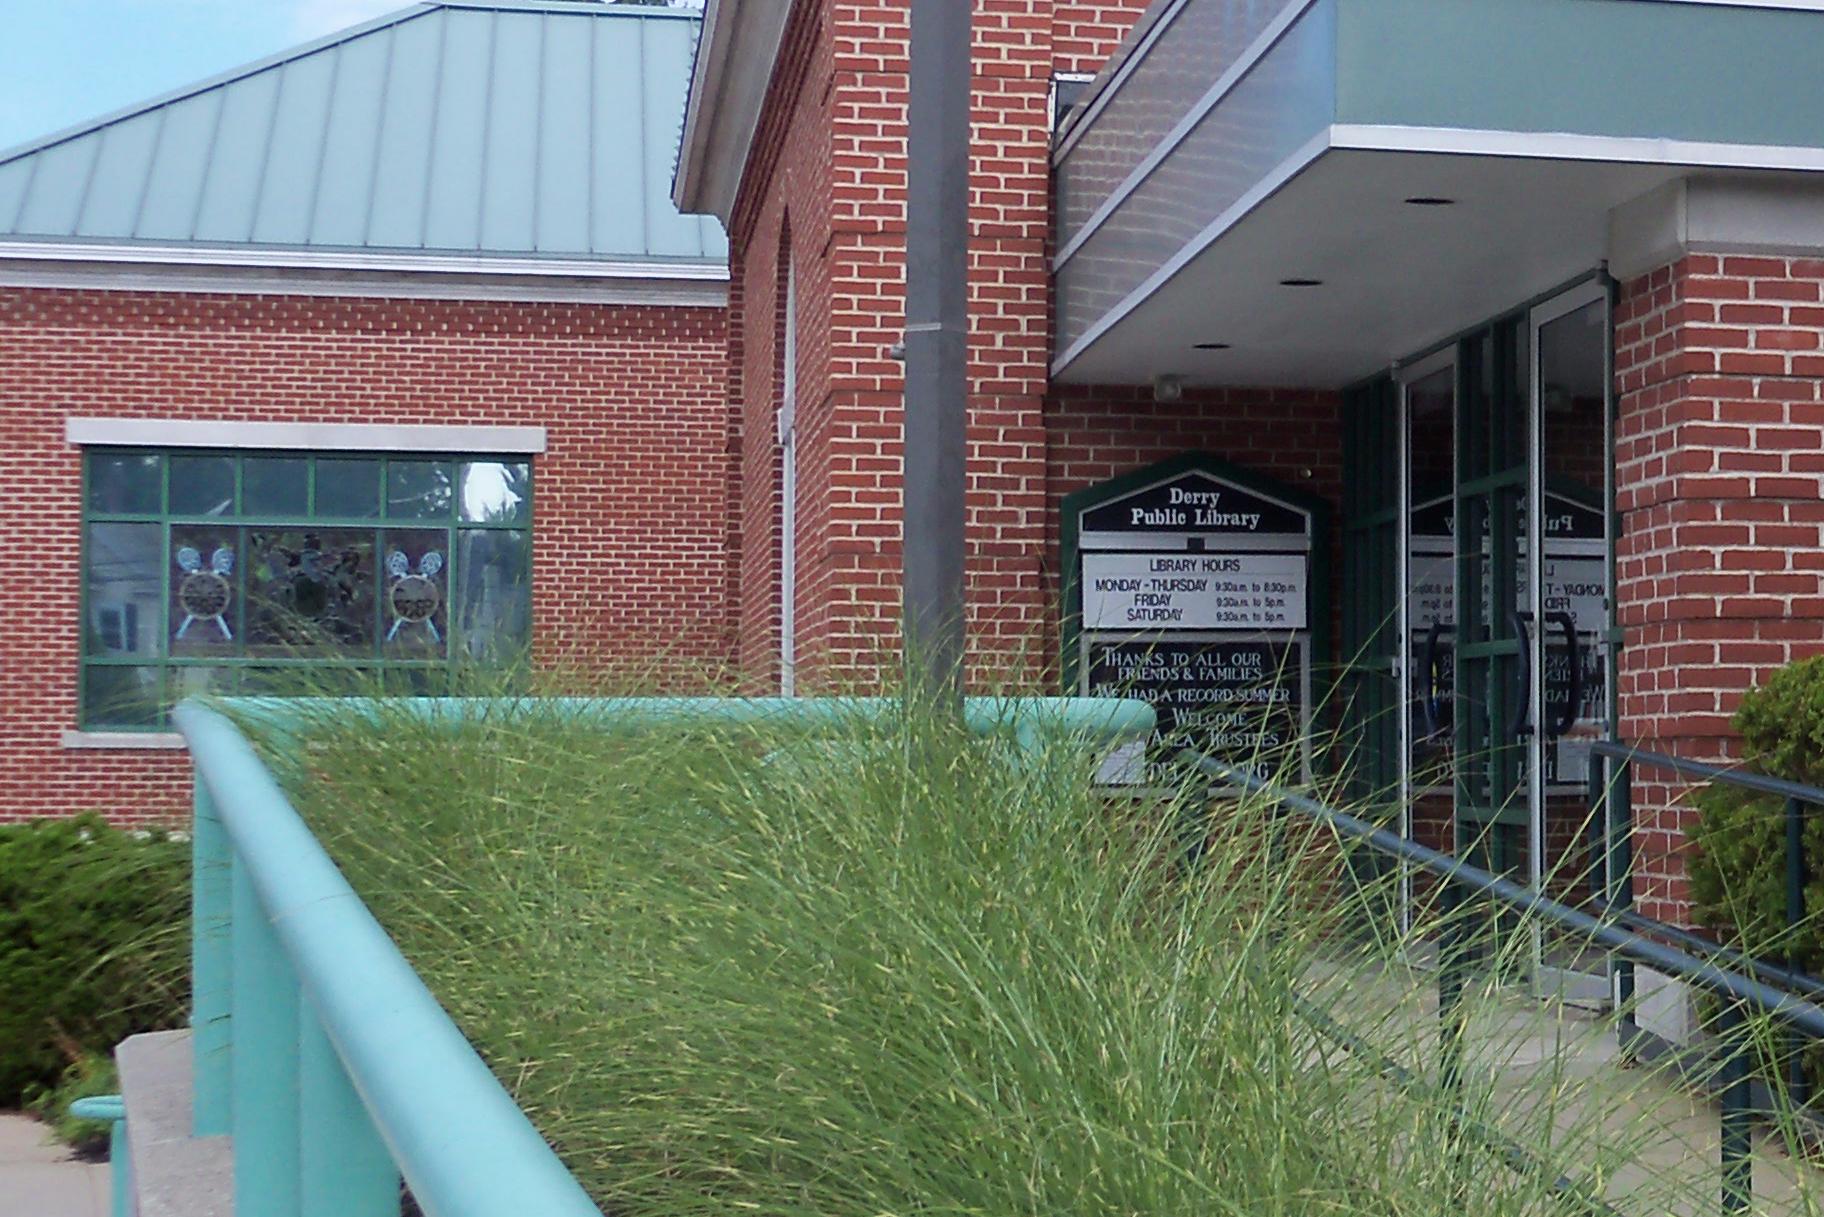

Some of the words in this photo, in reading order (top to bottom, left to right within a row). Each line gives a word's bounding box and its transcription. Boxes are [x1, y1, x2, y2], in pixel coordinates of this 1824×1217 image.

[1169, 487, 1220, 508] Derry
[1131, 508, 1186, 525] Public
[1194, 508, 1260, 529] Library
[1150, 560, 1197, 571] LIBRARY
[1202, 559, 1240, 571] HOURS
[1252, 582, 1261, 592] to
[1134, 594, 1172, 606] FRIDAY
[1253, 597, 1261, 607] to
[1127, 609, 1183, 621] SATURDAY
[1253, 612, 1261, 621] to
[1102, 647, 1165, 667] THANKS
[1171, 653, 1189, 666] TO
[1195, 652, 1226, 666] ALL
[1231, 652, 1261, 666] OUR
[1118, 667, 1179, 680] FRIENDS
[1183, 667, 1194, 680] &
[1200, 667, 1263, 680] FAMILIES
[1128, 688, 1159, 702] HAD
[1161, 689, 1173, 702] A
[1178, 688, 1233, 702] RECORD
